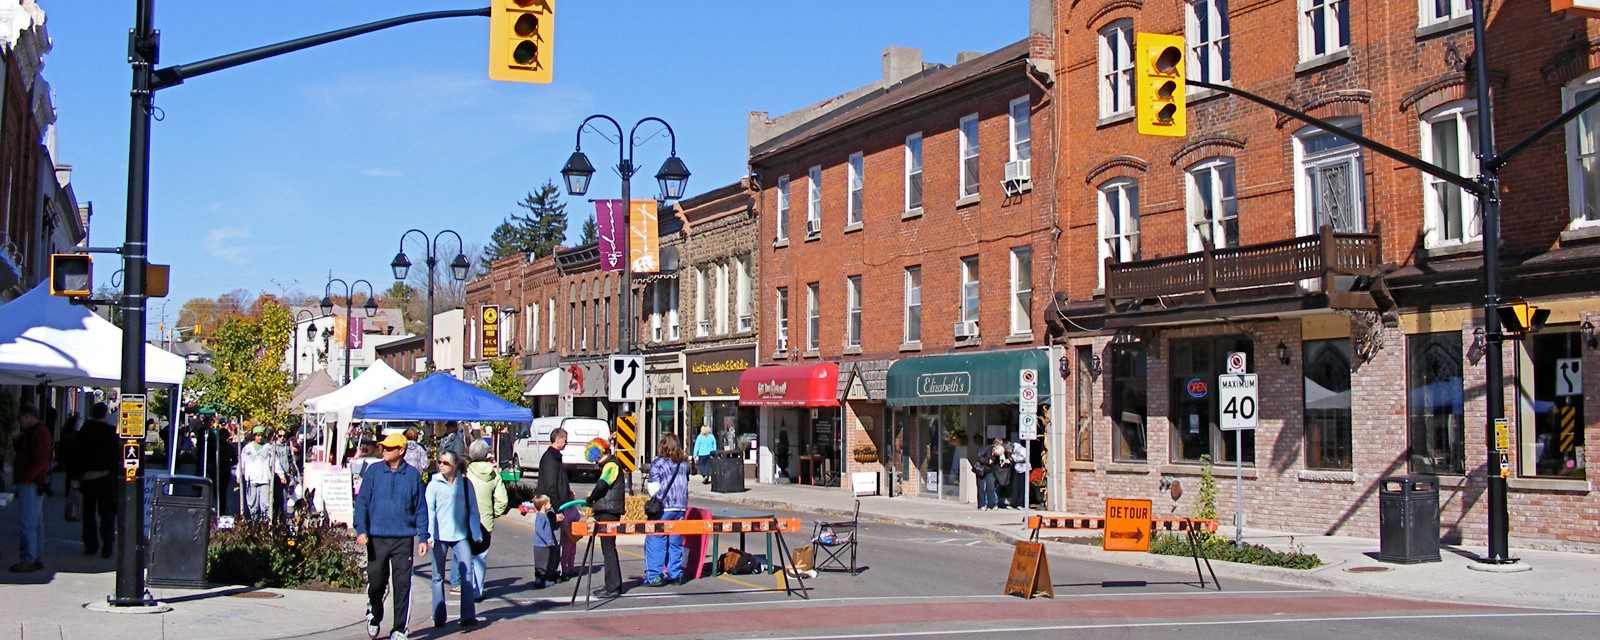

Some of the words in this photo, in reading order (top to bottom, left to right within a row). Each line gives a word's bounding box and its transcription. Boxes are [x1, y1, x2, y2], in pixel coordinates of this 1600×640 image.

[923, 376, 964, 393] Elizabeth's
[1189, 381, 1208, 393] OPEN
[1222, 380, 1255, 389] MAXIMUM
[1223, 396, 1255, 420] 40
[1110, 506, 1148, 519] DETOUR
